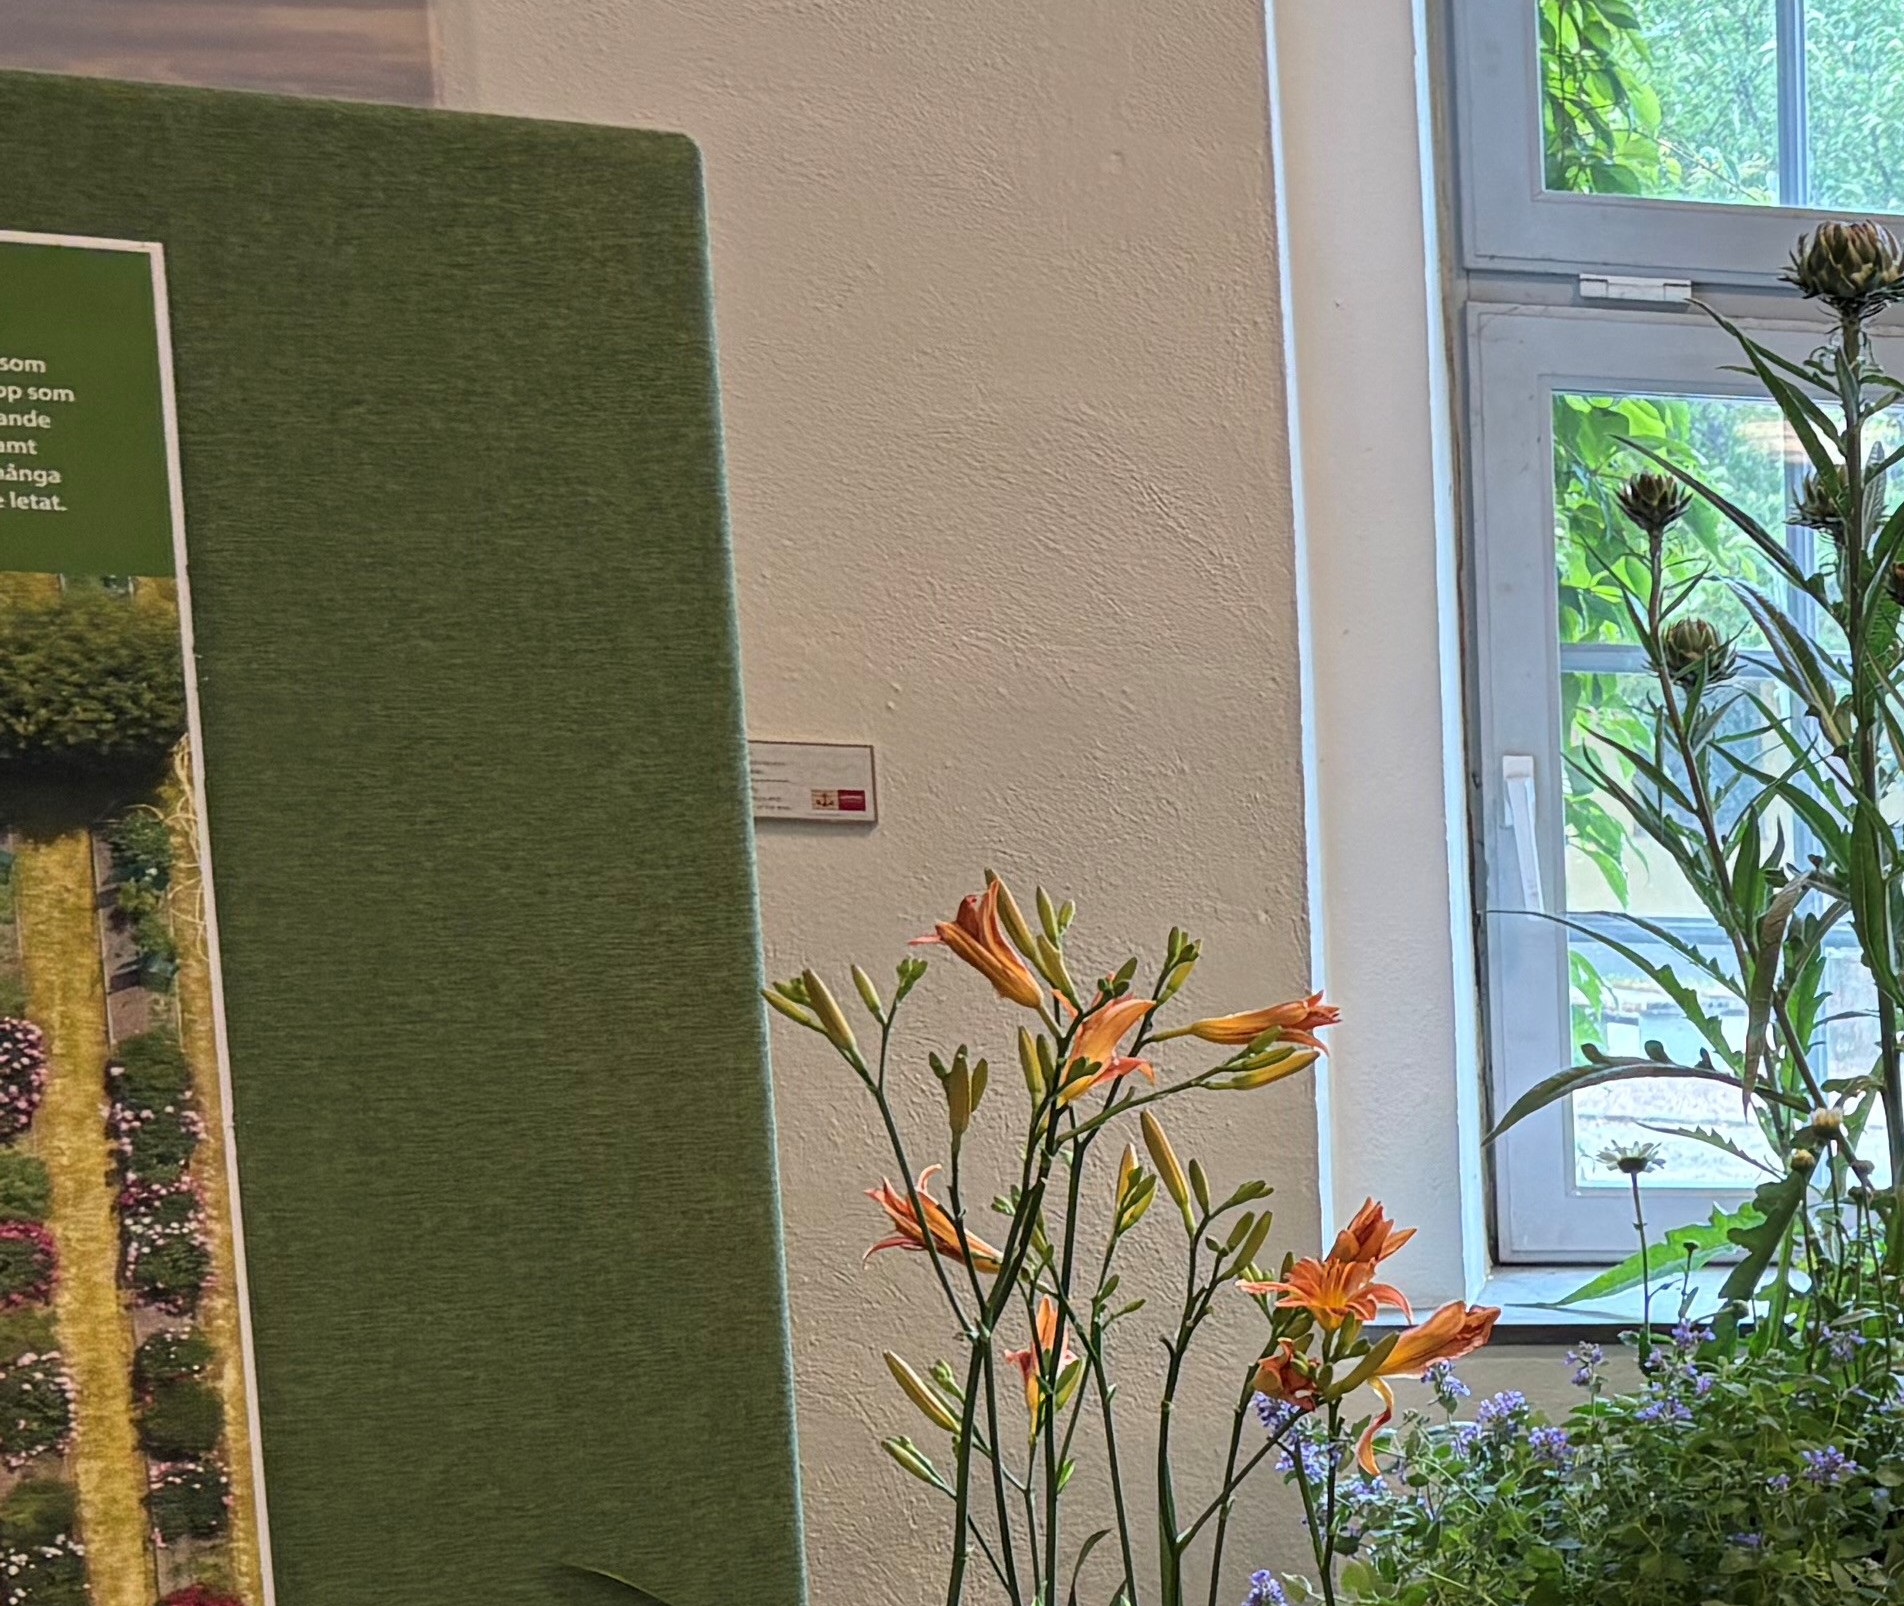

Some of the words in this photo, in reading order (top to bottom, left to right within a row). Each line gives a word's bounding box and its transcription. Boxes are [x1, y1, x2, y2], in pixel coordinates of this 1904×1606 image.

[27, 386, 75, 402] som
[0, 463, 62, 487] ånga
[9, 491, 68, 511] letat.
